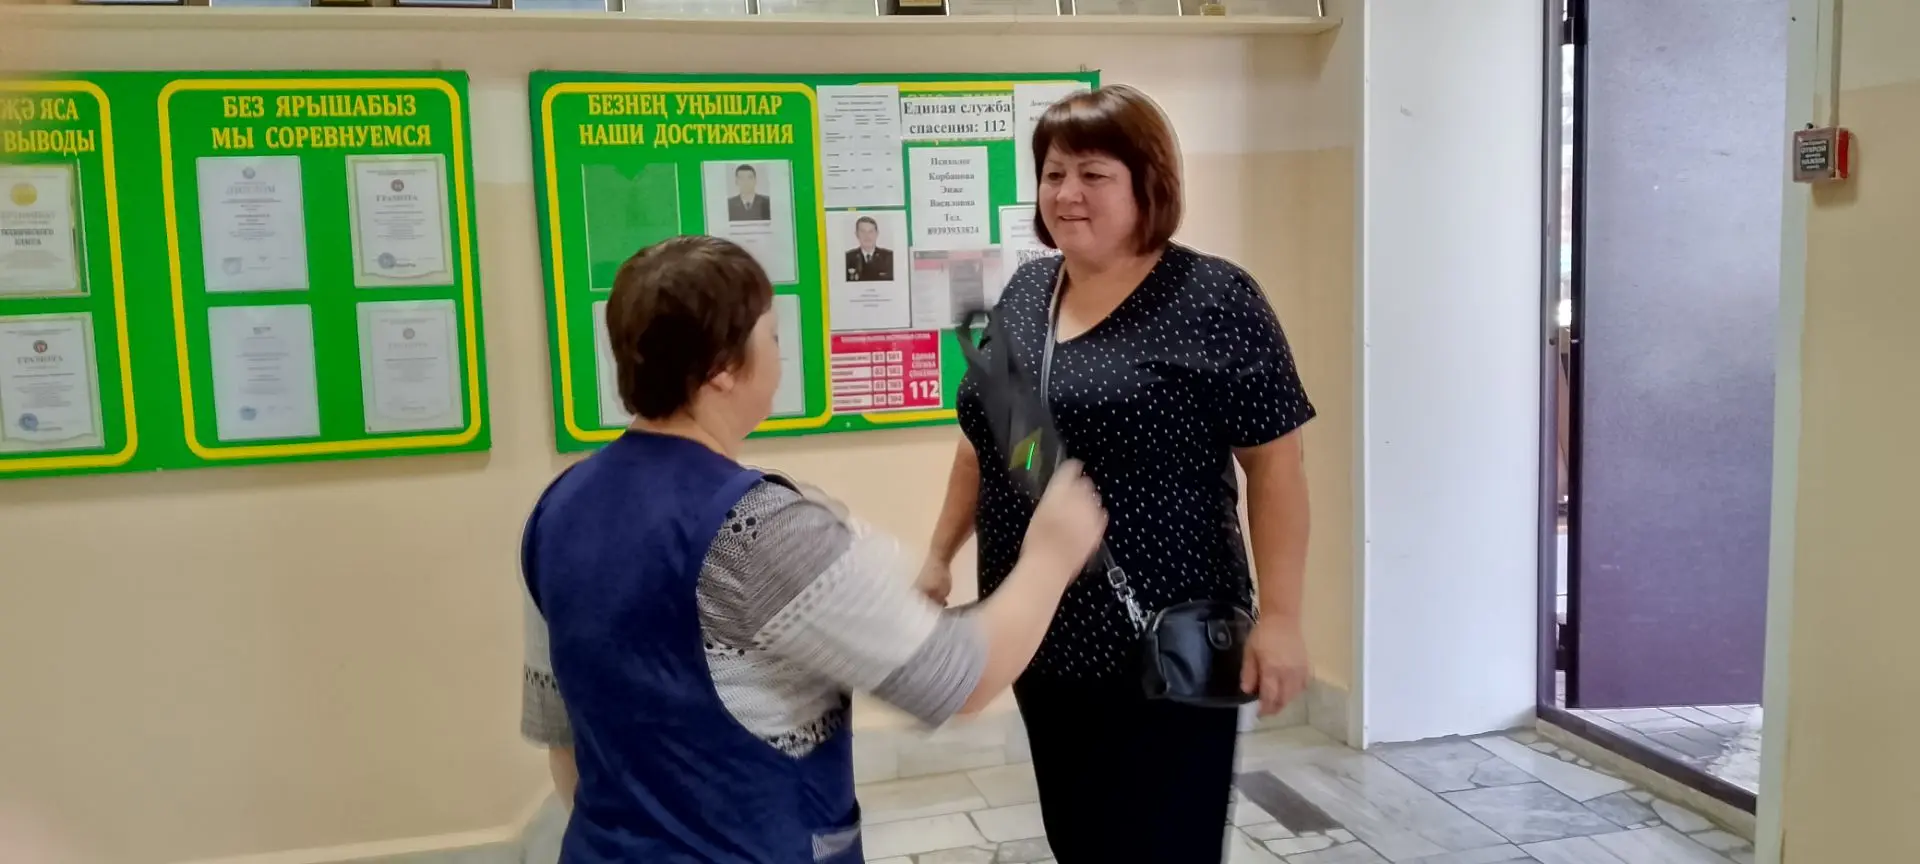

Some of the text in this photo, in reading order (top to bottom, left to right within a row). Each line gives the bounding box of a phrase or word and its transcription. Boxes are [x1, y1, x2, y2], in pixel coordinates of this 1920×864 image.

[40, 97, 79, 121] ЯСА
[223, 94, 417, 118] БЕЗ ЯРЫШАБЫЗ
[587, 93, 783, 119] БЕЗНЕҢ УҢЫШЛАР
[903, 100, 1011, 116] Единая служба
[211, 125, 432, 149] МЫ СОРЕВНУЕМСЯ
[579, 123, 795, 148] НАШИ ДОСТИЖЕНИЯ
[909, 119, 1007, 134] спасения: 112
[4, 129, 96, 157] ВЫВОДЫ
[909, 380, 940, 400] 112
